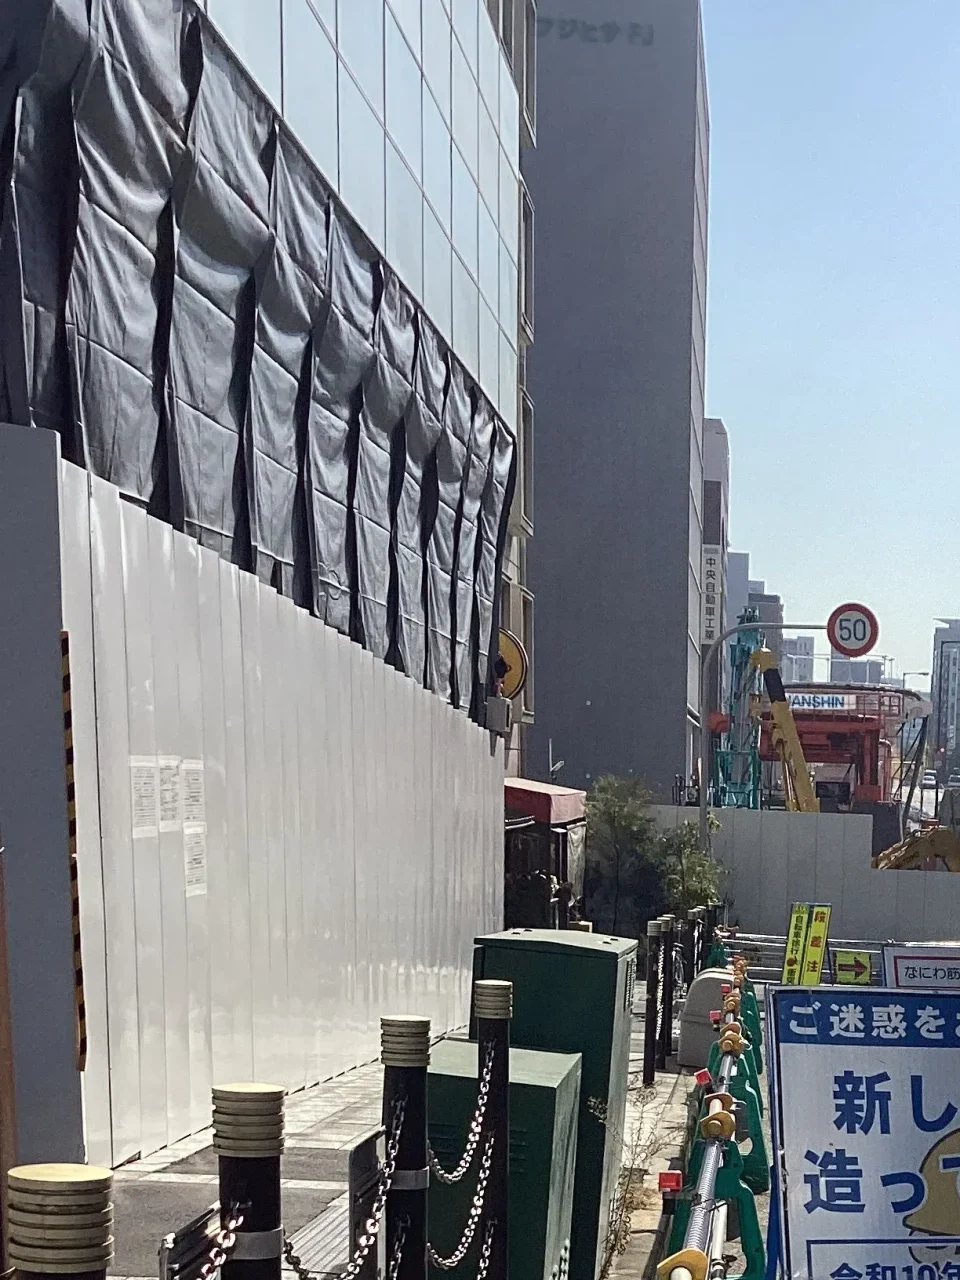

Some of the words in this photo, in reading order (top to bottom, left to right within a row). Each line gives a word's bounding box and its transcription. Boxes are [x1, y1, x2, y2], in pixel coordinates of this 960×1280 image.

[705, 557, 717, 641] 中央自動車工業
[838, 618, 867, 642] 50
